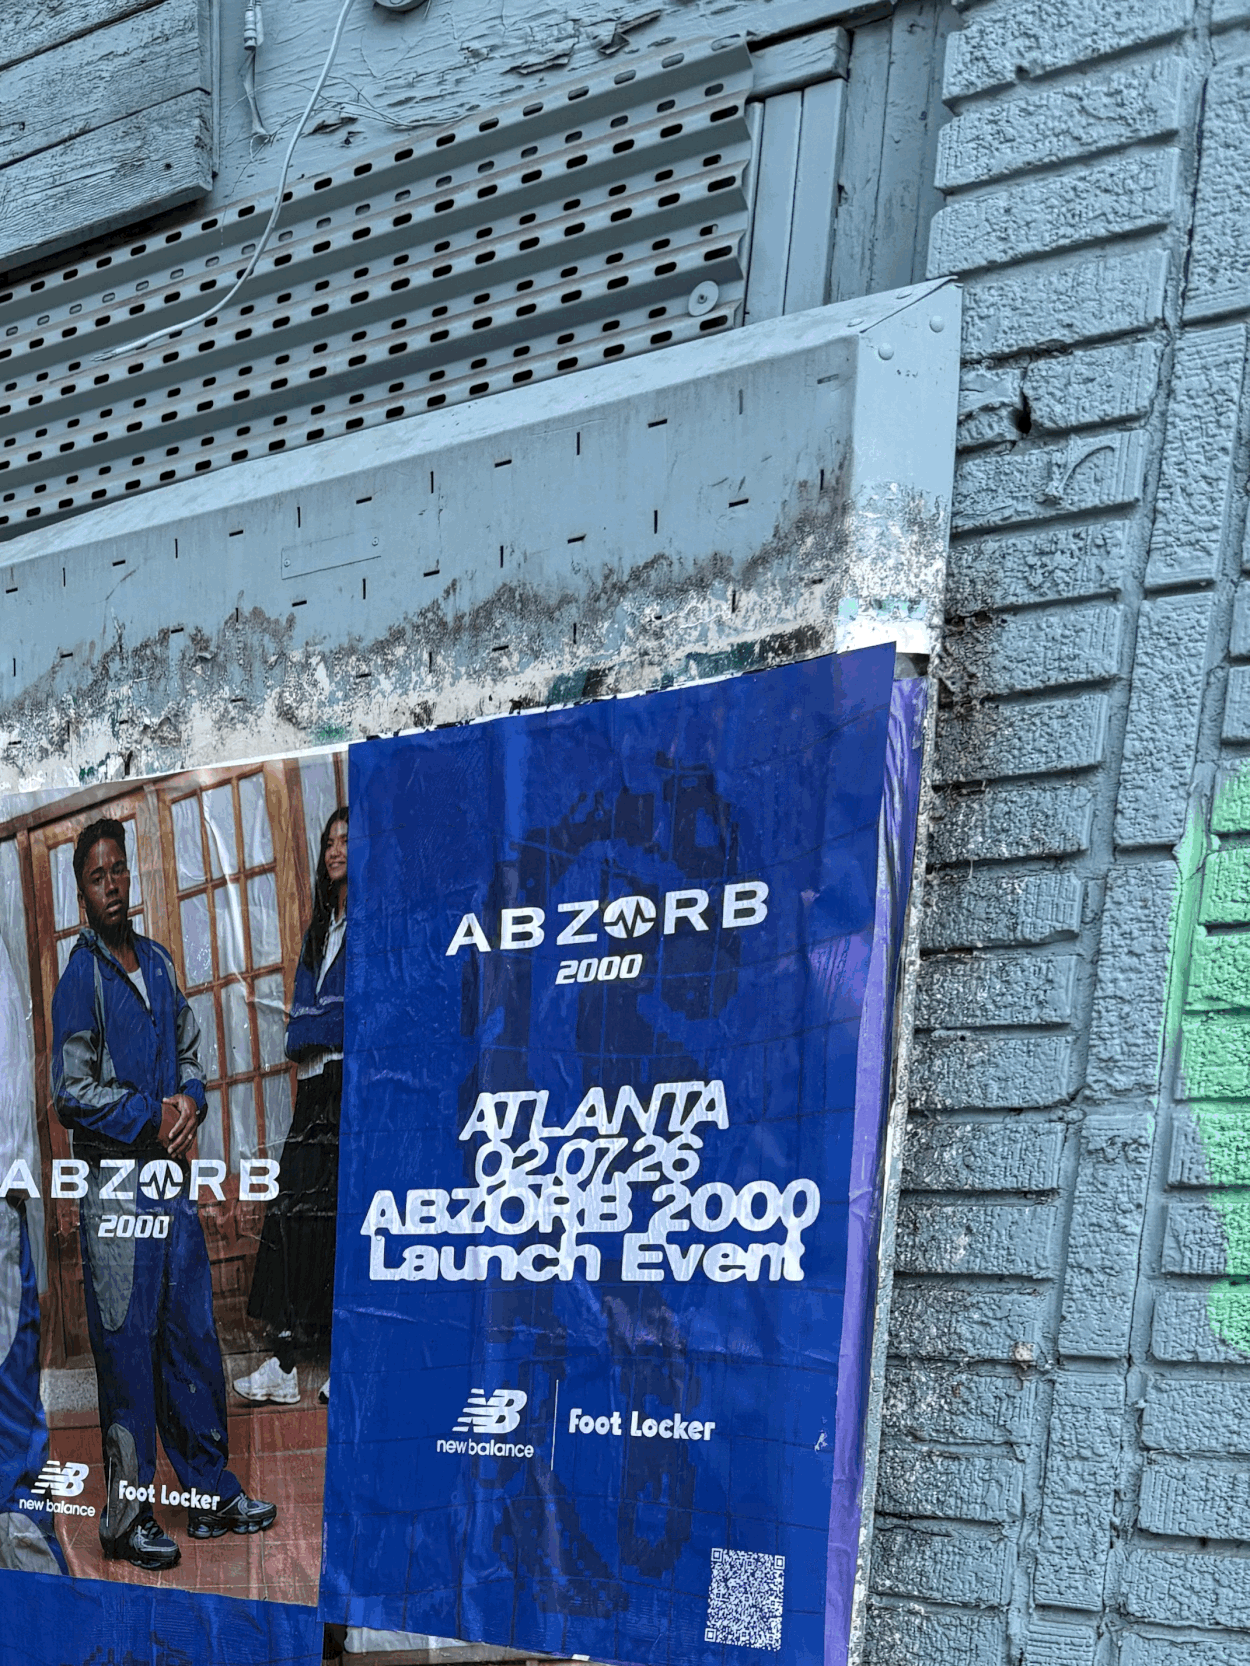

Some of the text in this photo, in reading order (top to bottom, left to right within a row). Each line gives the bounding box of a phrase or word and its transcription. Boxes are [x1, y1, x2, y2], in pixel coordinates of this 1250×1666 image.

[446, 881, 770, 956] ABZORB
[555, 953, 643, 985] 2000
[458, 1079, 730, 1141] ATLANTA
[360, 1179, 820, 1235] ABZORB 2000
[98, 1214, 172, 1239] 2000
[369, 1233, 805, 1281] Launch Event
[568, 1407, 716, 1442] Foot Locker
[437, 1437, 535, 1459] new balance
[18, 1498, 96, 1517] new balance
[118, 1480, 220, 1511] Foot Locker
